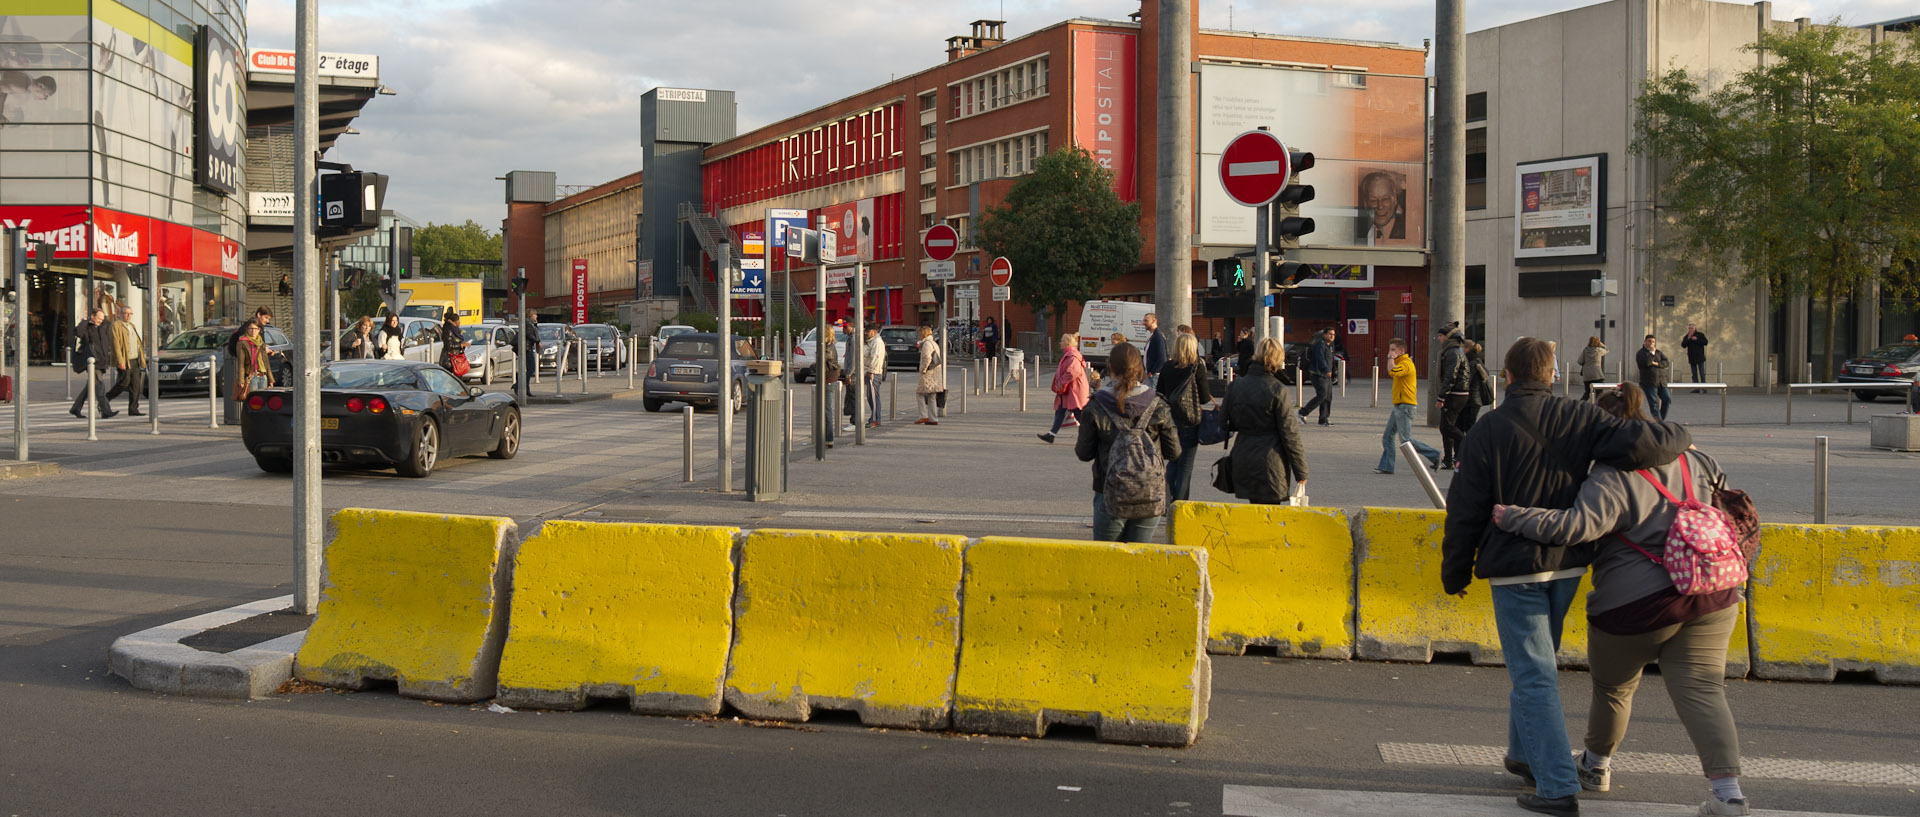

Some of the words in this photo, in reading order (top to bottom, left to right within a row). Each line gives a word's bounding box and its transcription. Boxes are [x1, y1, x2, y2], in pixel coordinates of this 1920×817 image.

[258, 54, 276, 66] Club
[277, 55, 288, 66] De
[289, 56, 296, 67] G
[336, 56, 369, 74] étage
[208, 49, 236, 145] GO
[665, 90, 704, 100] TRIPOSTAL
[1098, 50, 1113, 170] RIPOSTAL
[779, 105, 903, 182] TRIPOSTAL
[208, 154, 236, 189] SPORT
